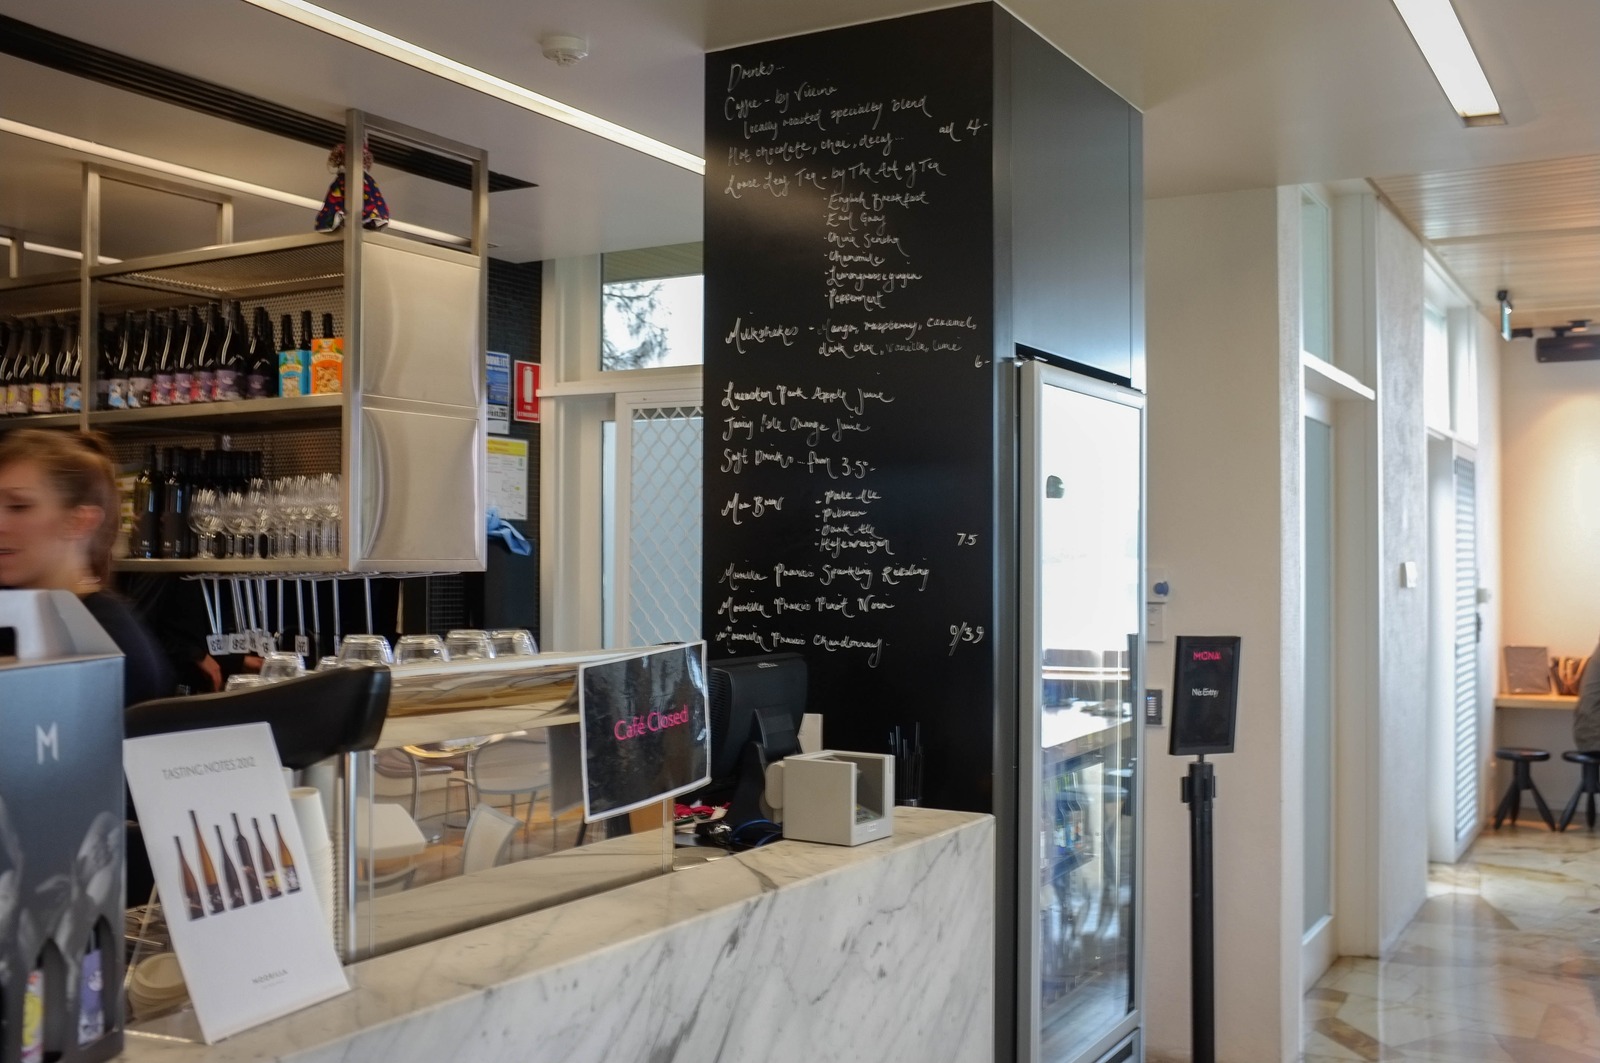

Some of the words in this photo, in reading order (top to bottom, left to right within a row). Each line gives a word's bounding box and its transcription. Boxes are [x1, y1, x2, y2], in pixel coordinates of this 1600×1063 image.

[613, 716, 646, 741] Café
[647, 704, 689, 731] Closed
[35, 721, 60, 766] M
[162, 764, 204, 780] TASTING
[203, 759, 236, 774] NOTES
